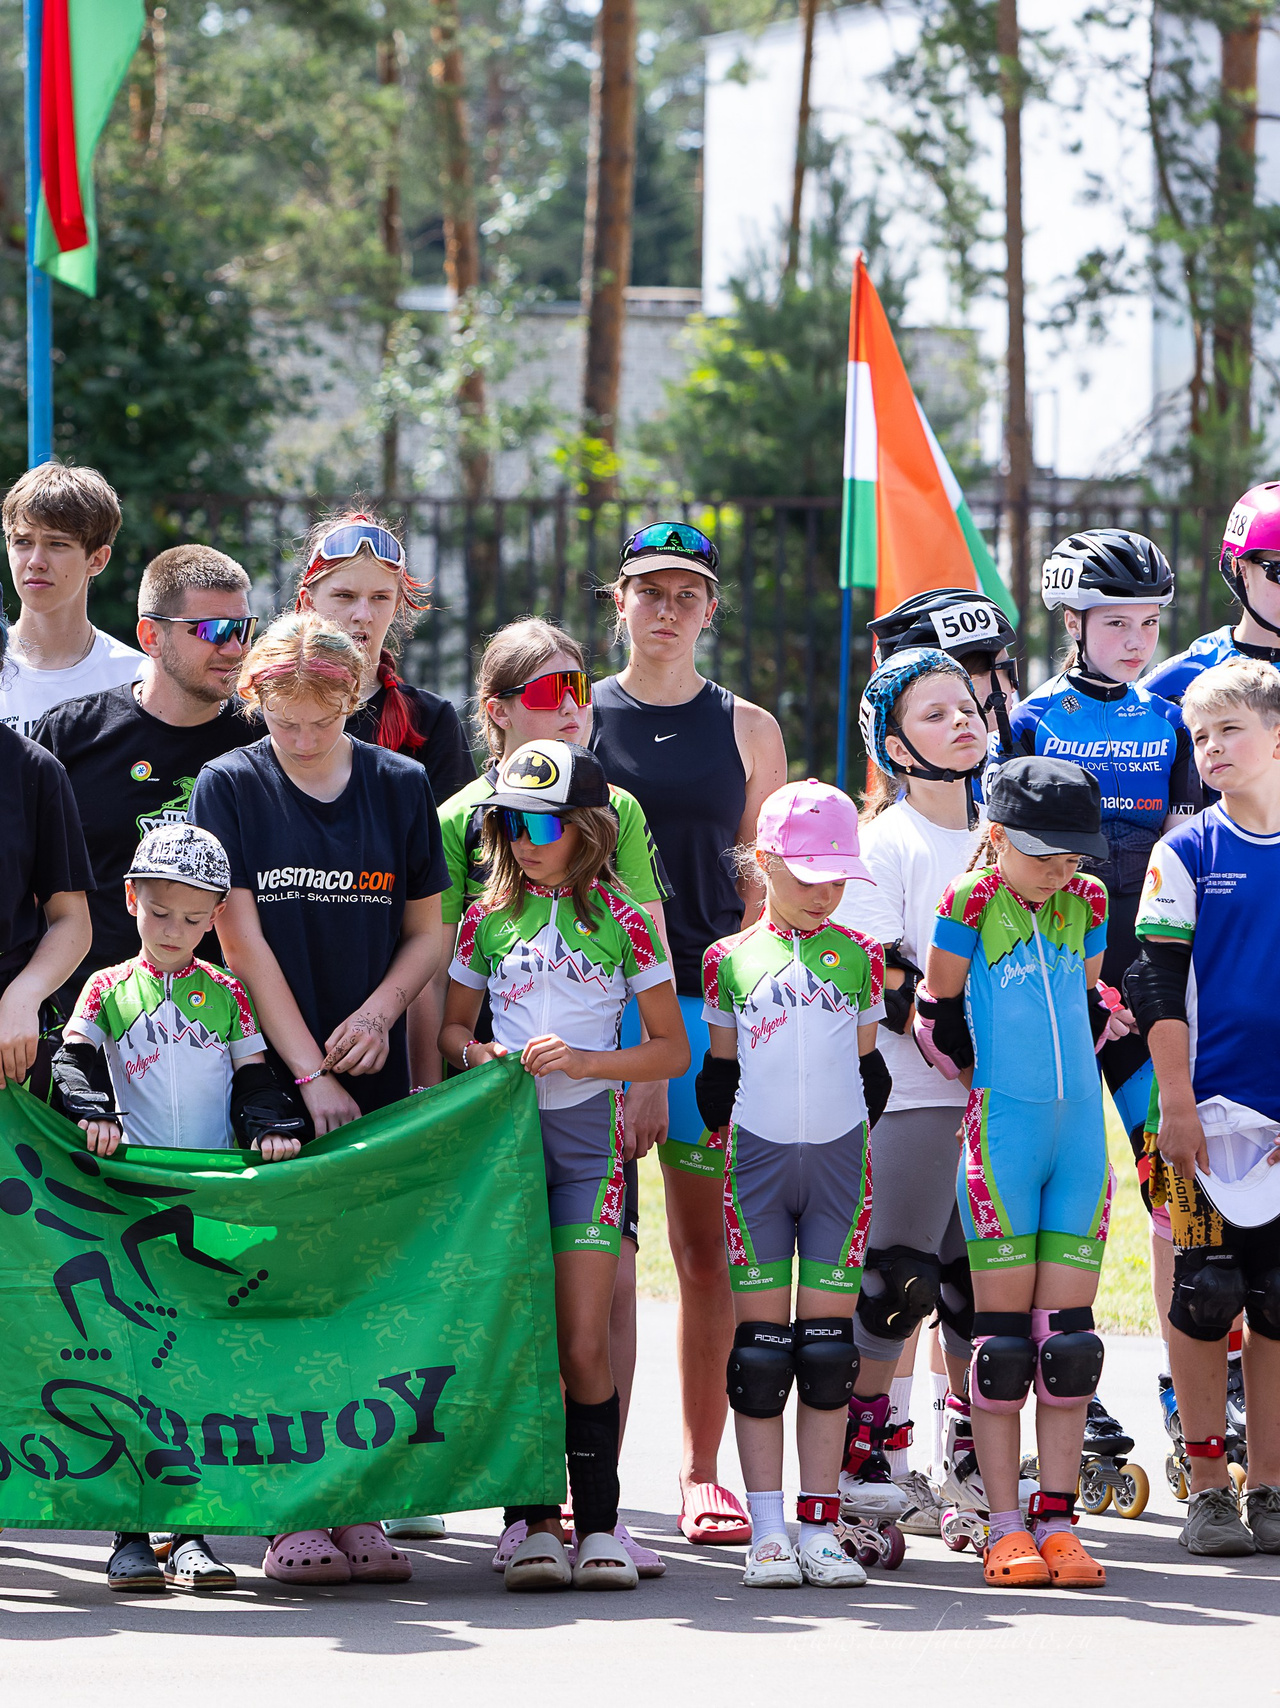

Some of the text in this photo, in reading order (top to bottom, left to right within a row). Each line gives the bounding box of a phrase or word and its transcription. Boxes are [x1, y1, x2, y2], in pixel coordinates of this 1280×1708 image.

[1044, 567, 1074, 590] 510
[942, 608, 991, 638] 509
[1043, 737, 1170, 758] POWERSLIDE
[1113, 762, 1127, 771] TO
[1129, 760, 1162, 772] SKATE.
[1101, 796, 1163, 811] maco.com
[257, 867, 396, 892] vesmaco.com
[680, 1159, 715, 1172] ROADSTAR
[574, 1238, 610, 1246] ROADSTAR
[986, 1253, 1027, 1263] ROADSTAR
[1063, 1253, 1100, 1266] ROADSTAR
[739, 1277, 774, 1286] ROADSTAR
[820, 1278, 854, 1287] ROADSTAR
[805, 1328, 842, 1336] RIDEUP
[754, 1333, 792, 1344] RIDEUP
